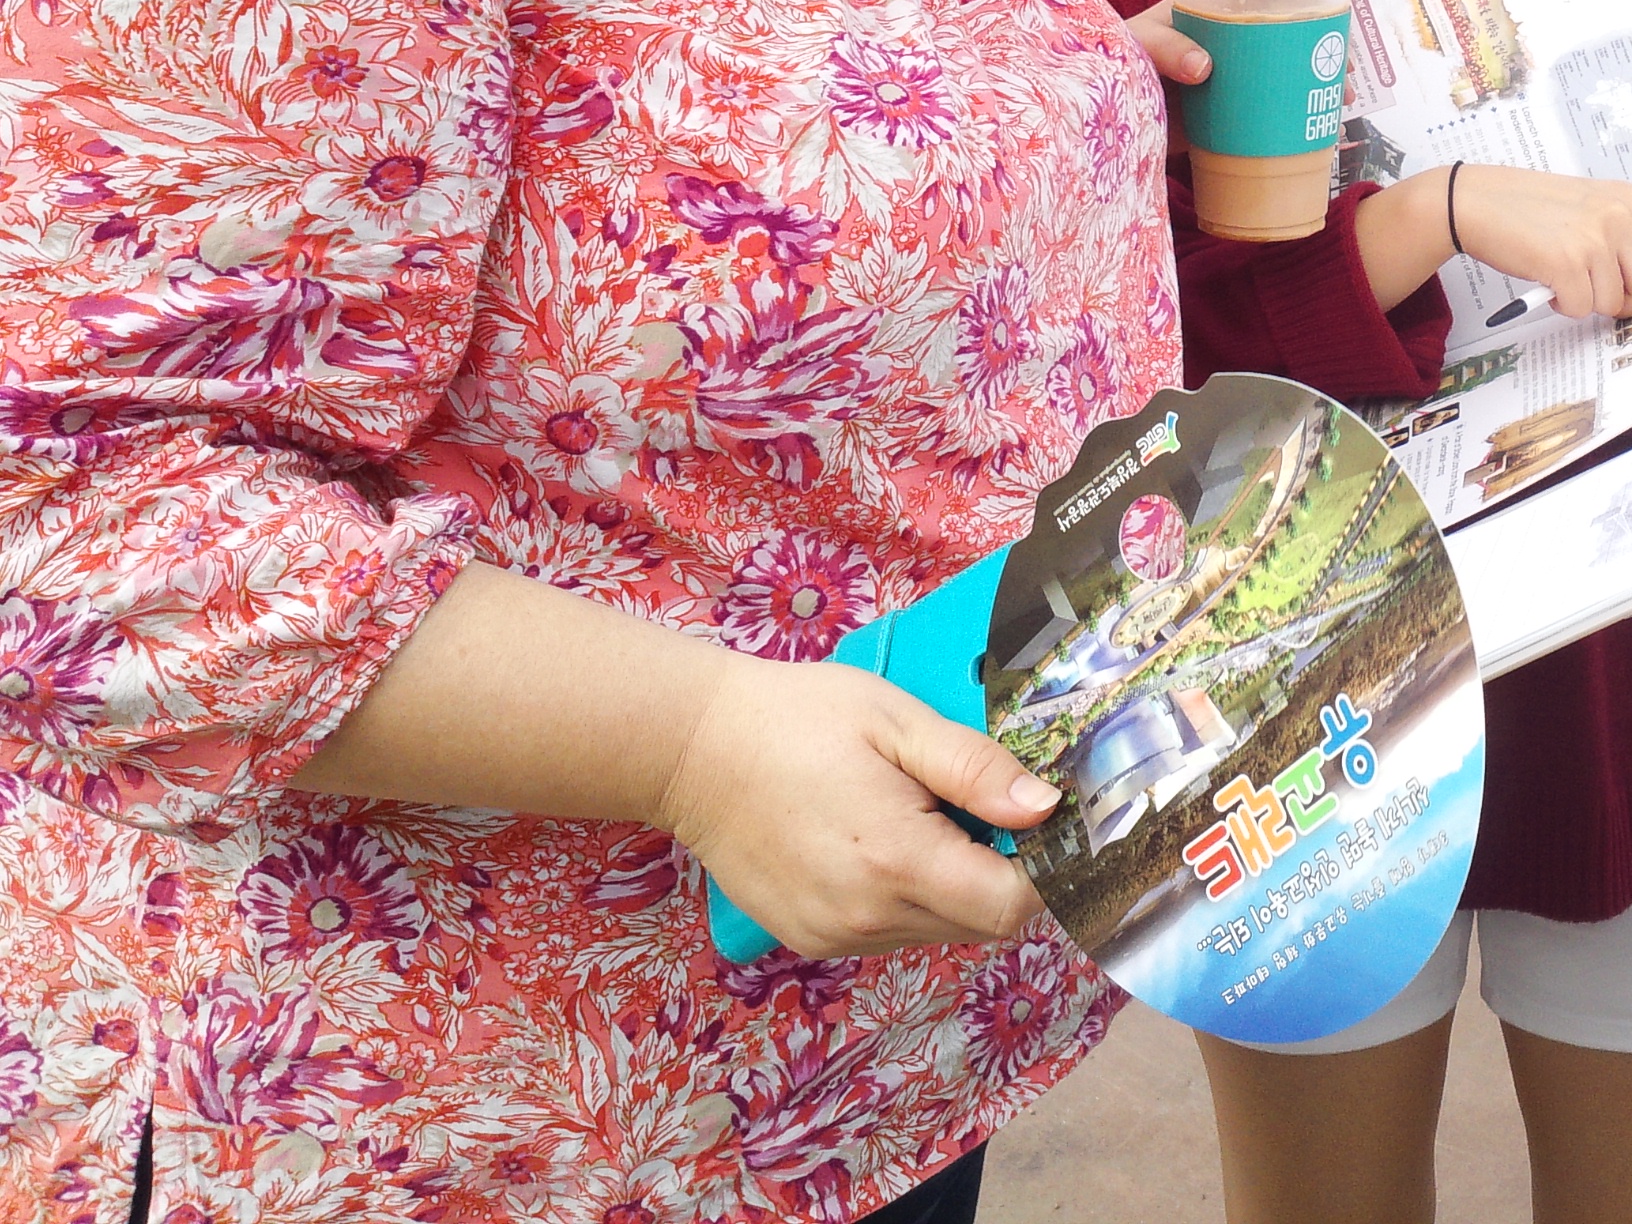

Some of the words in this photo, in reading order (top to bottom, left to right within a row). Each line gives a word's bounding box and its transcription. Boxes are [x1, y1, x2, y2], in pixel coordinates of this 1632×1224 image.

[1362, 17, 1382, 50] Cultural
[1372, 49, 1394, 84] Heritage
[1507, 108, 1533, 161] Redemption
[1521, 105, 1539, 138] Launch
[1054, 455, 1141, 534] 경상북도관광공사
[1186, 694, 1377, 901] 유교랜드
[1369, 774, 1435, 839] 신나게
[1332, 817, 1382, 870] 놀면
[1243, 846, 1341, 933] 인성교육이
[1300, 905, 1350, 950] 유교문화
